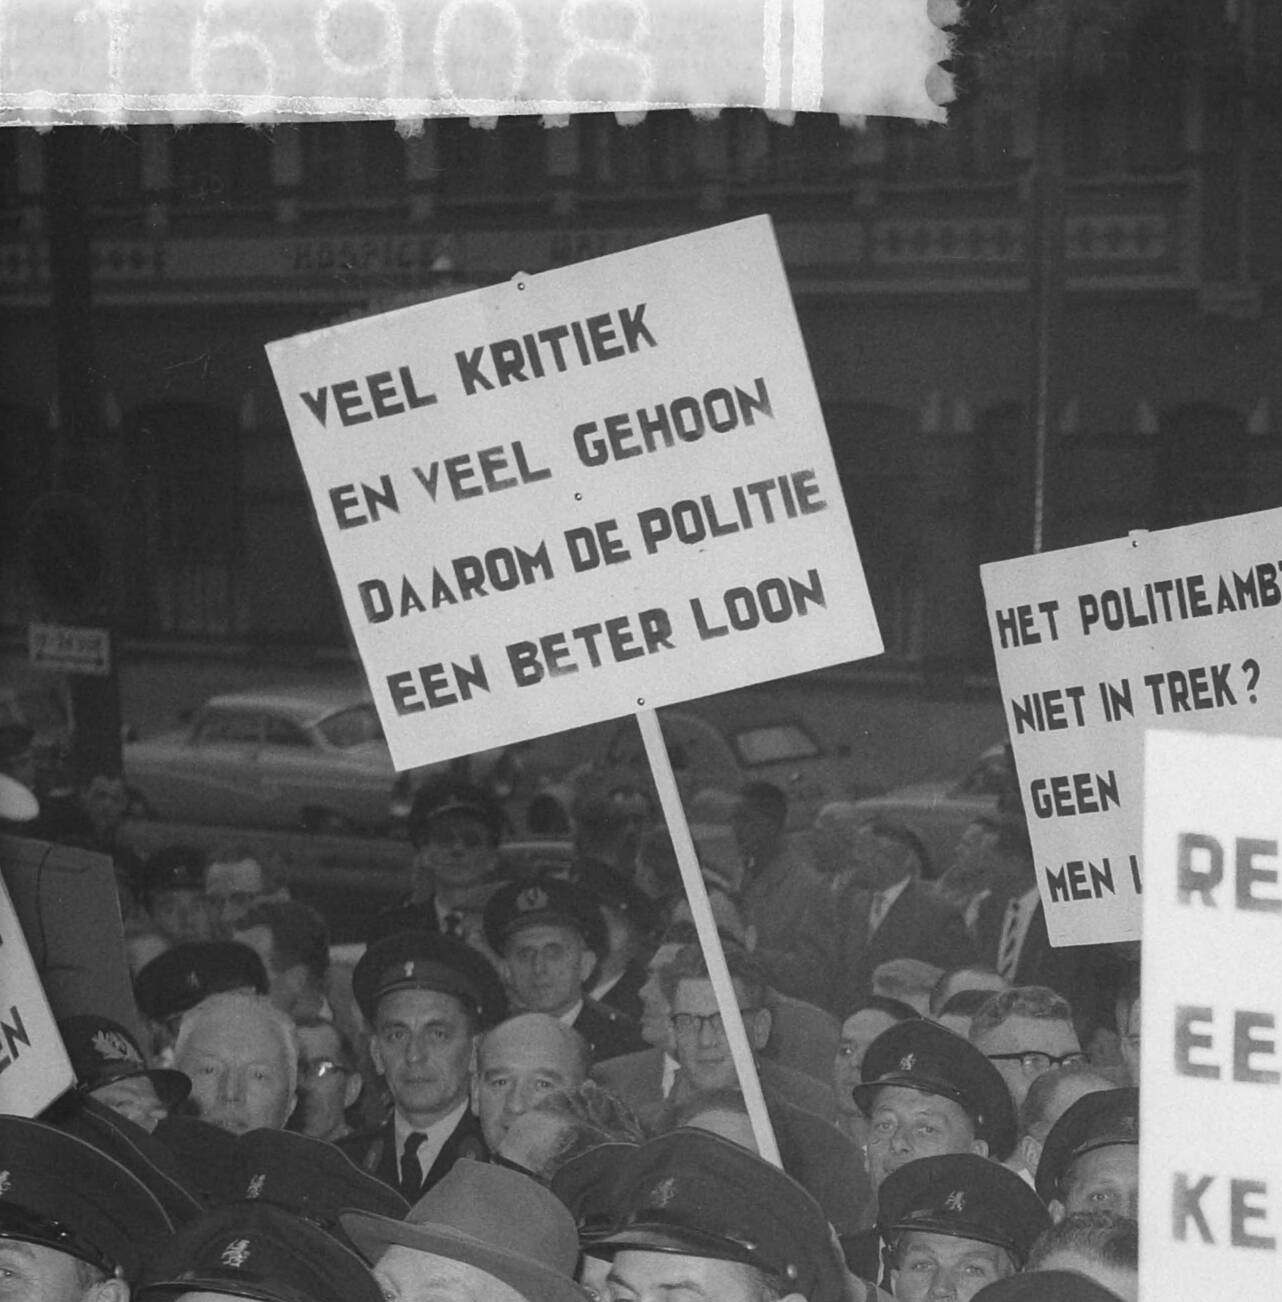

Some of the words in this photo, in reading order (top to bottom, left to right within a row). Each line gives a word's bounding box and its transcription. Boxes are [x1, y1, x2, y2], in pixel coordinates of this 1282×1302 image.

[300, 367, 437, 426] VEEL
[456, 304, 656, 395] KRITIEK
[329, 475, 398, 529] EN
[414, 442, 550, 500] VEEL
[574, 378, 770, 466] GEHOON
[359, 542, 553, 623] DAAROM
[565, 520, 630, 572] DE
[638, 471, 825, 553] POLITIE
[387, 655, 489, 715] EEN
[506, 609, 674, 687] BETER
[690, 570, 824, 639] LOON
[996, 601, 1059, 648] HET
[1012, 687, 1084, 733] NIET
[1100, 679, 1133, 721] IN
[1031, 771, 1119, 818] GEEN
[1046, 859, 1114, 902] MEN
